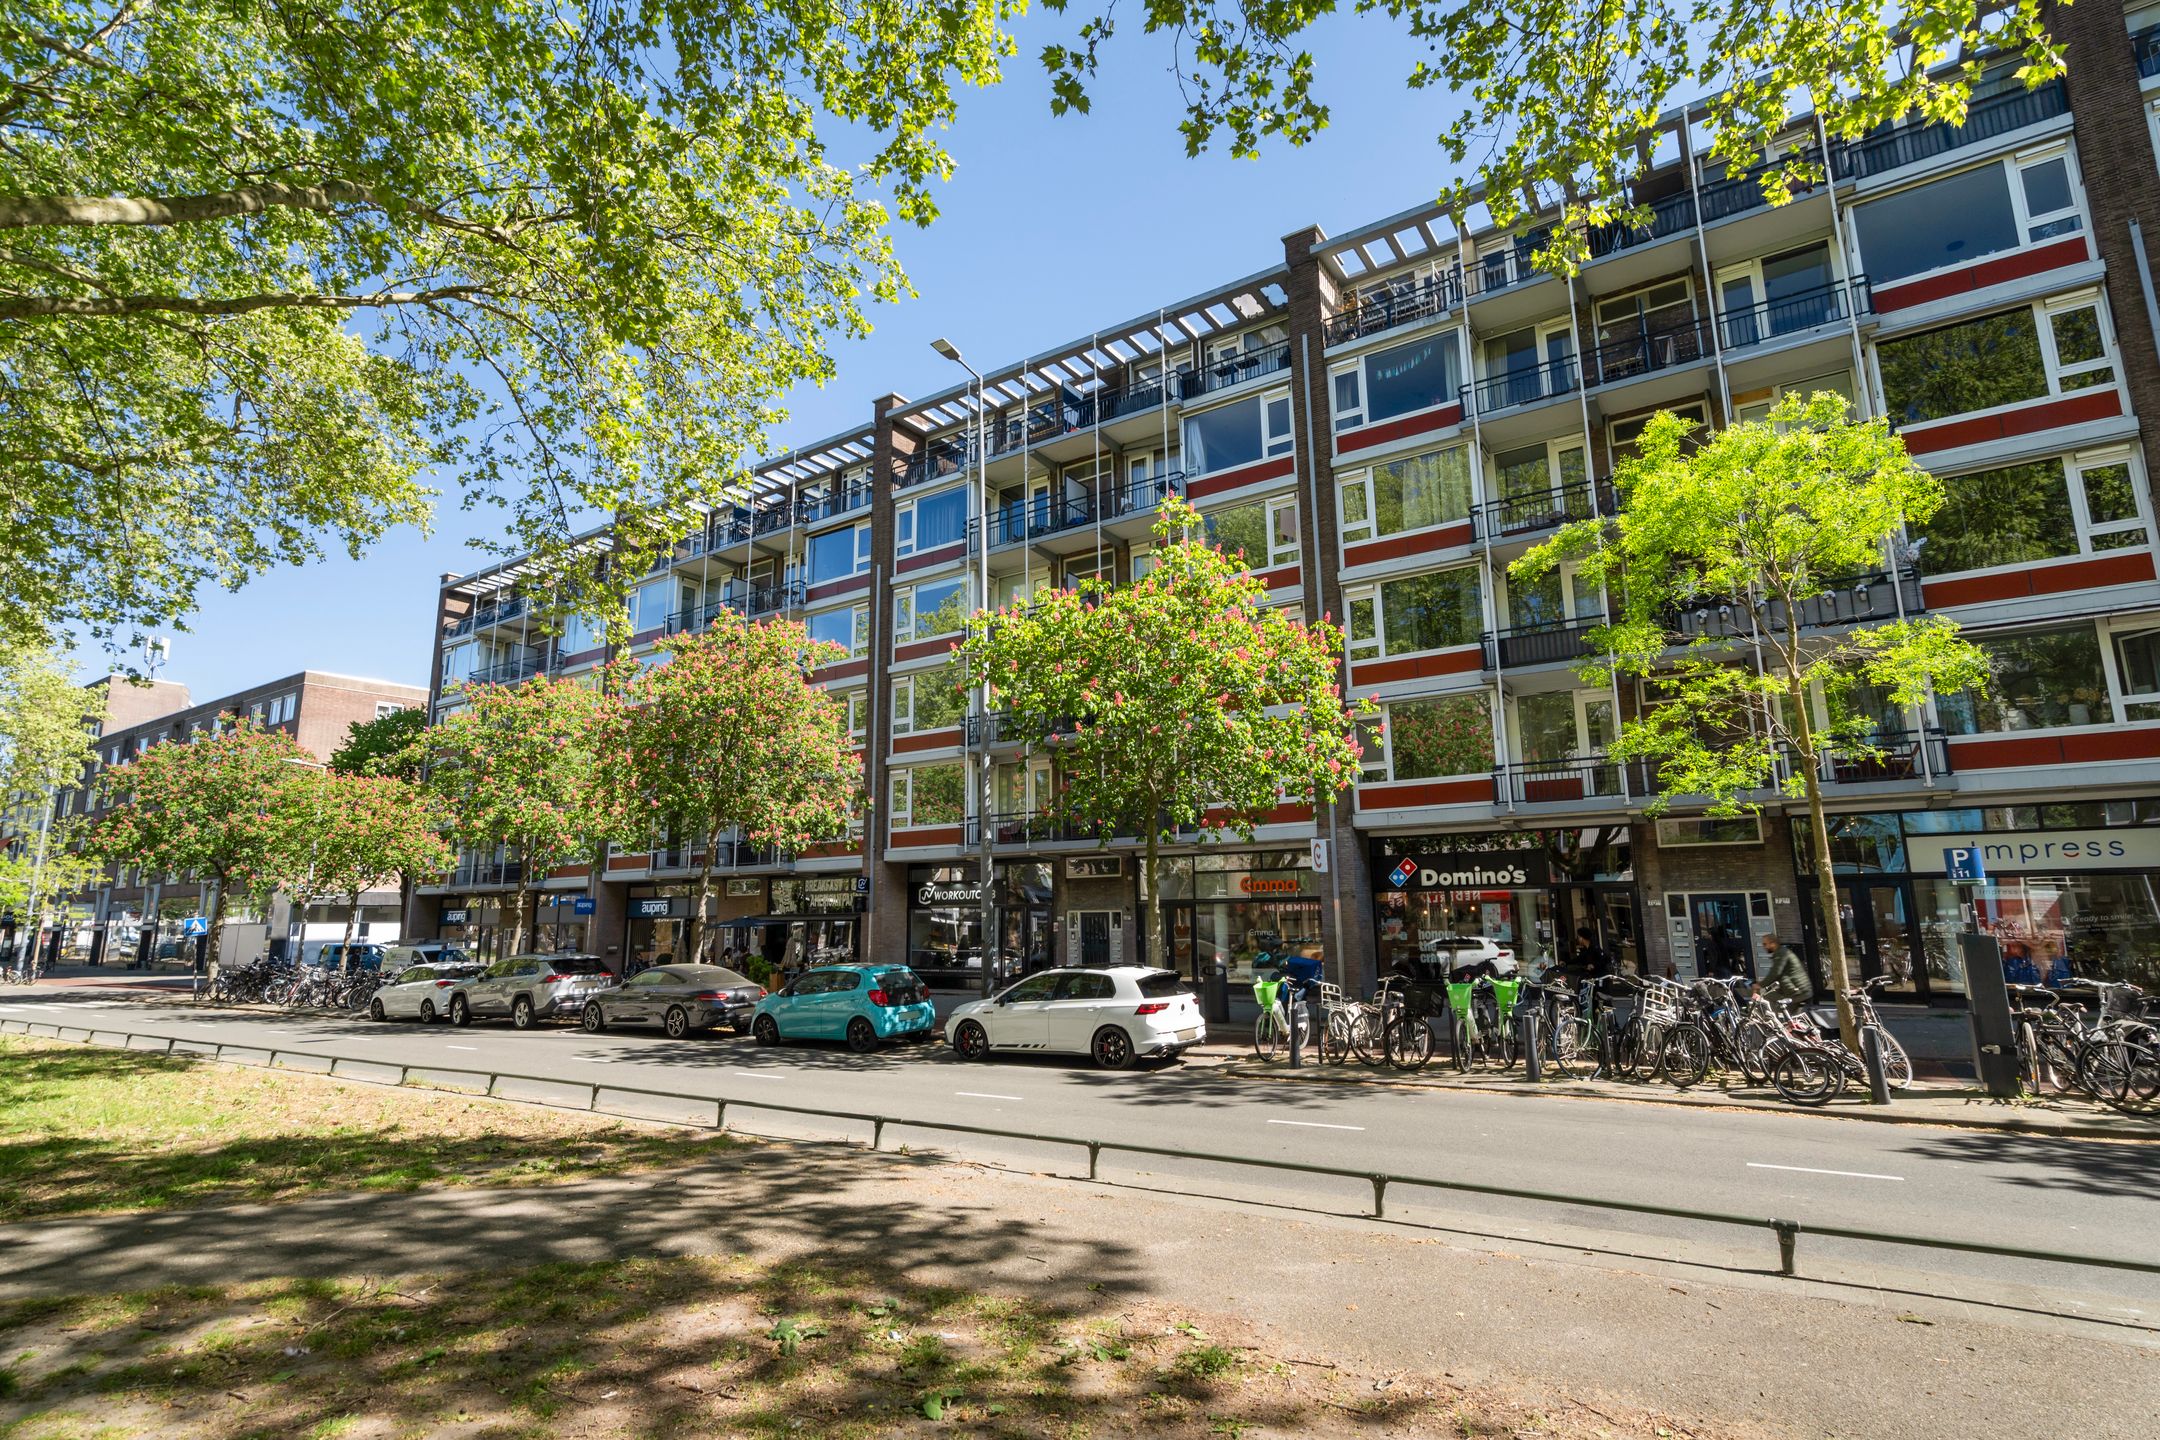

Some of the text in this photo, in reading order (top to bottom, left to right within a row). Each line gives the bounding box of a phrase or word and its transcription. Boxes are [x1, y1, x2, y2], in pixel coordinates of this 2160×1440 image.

[1952, 849, 1969, 868] P
[1421, 864, 1527, 887] Domino's
[1240, 876, 1297, 893] Emma
[934, 889, 996, 901] WORKOUTCB
[641, 901, 668, 915] auping
[446, 911, 466, 923] auping
[2100, 913, 2109, 921] to
